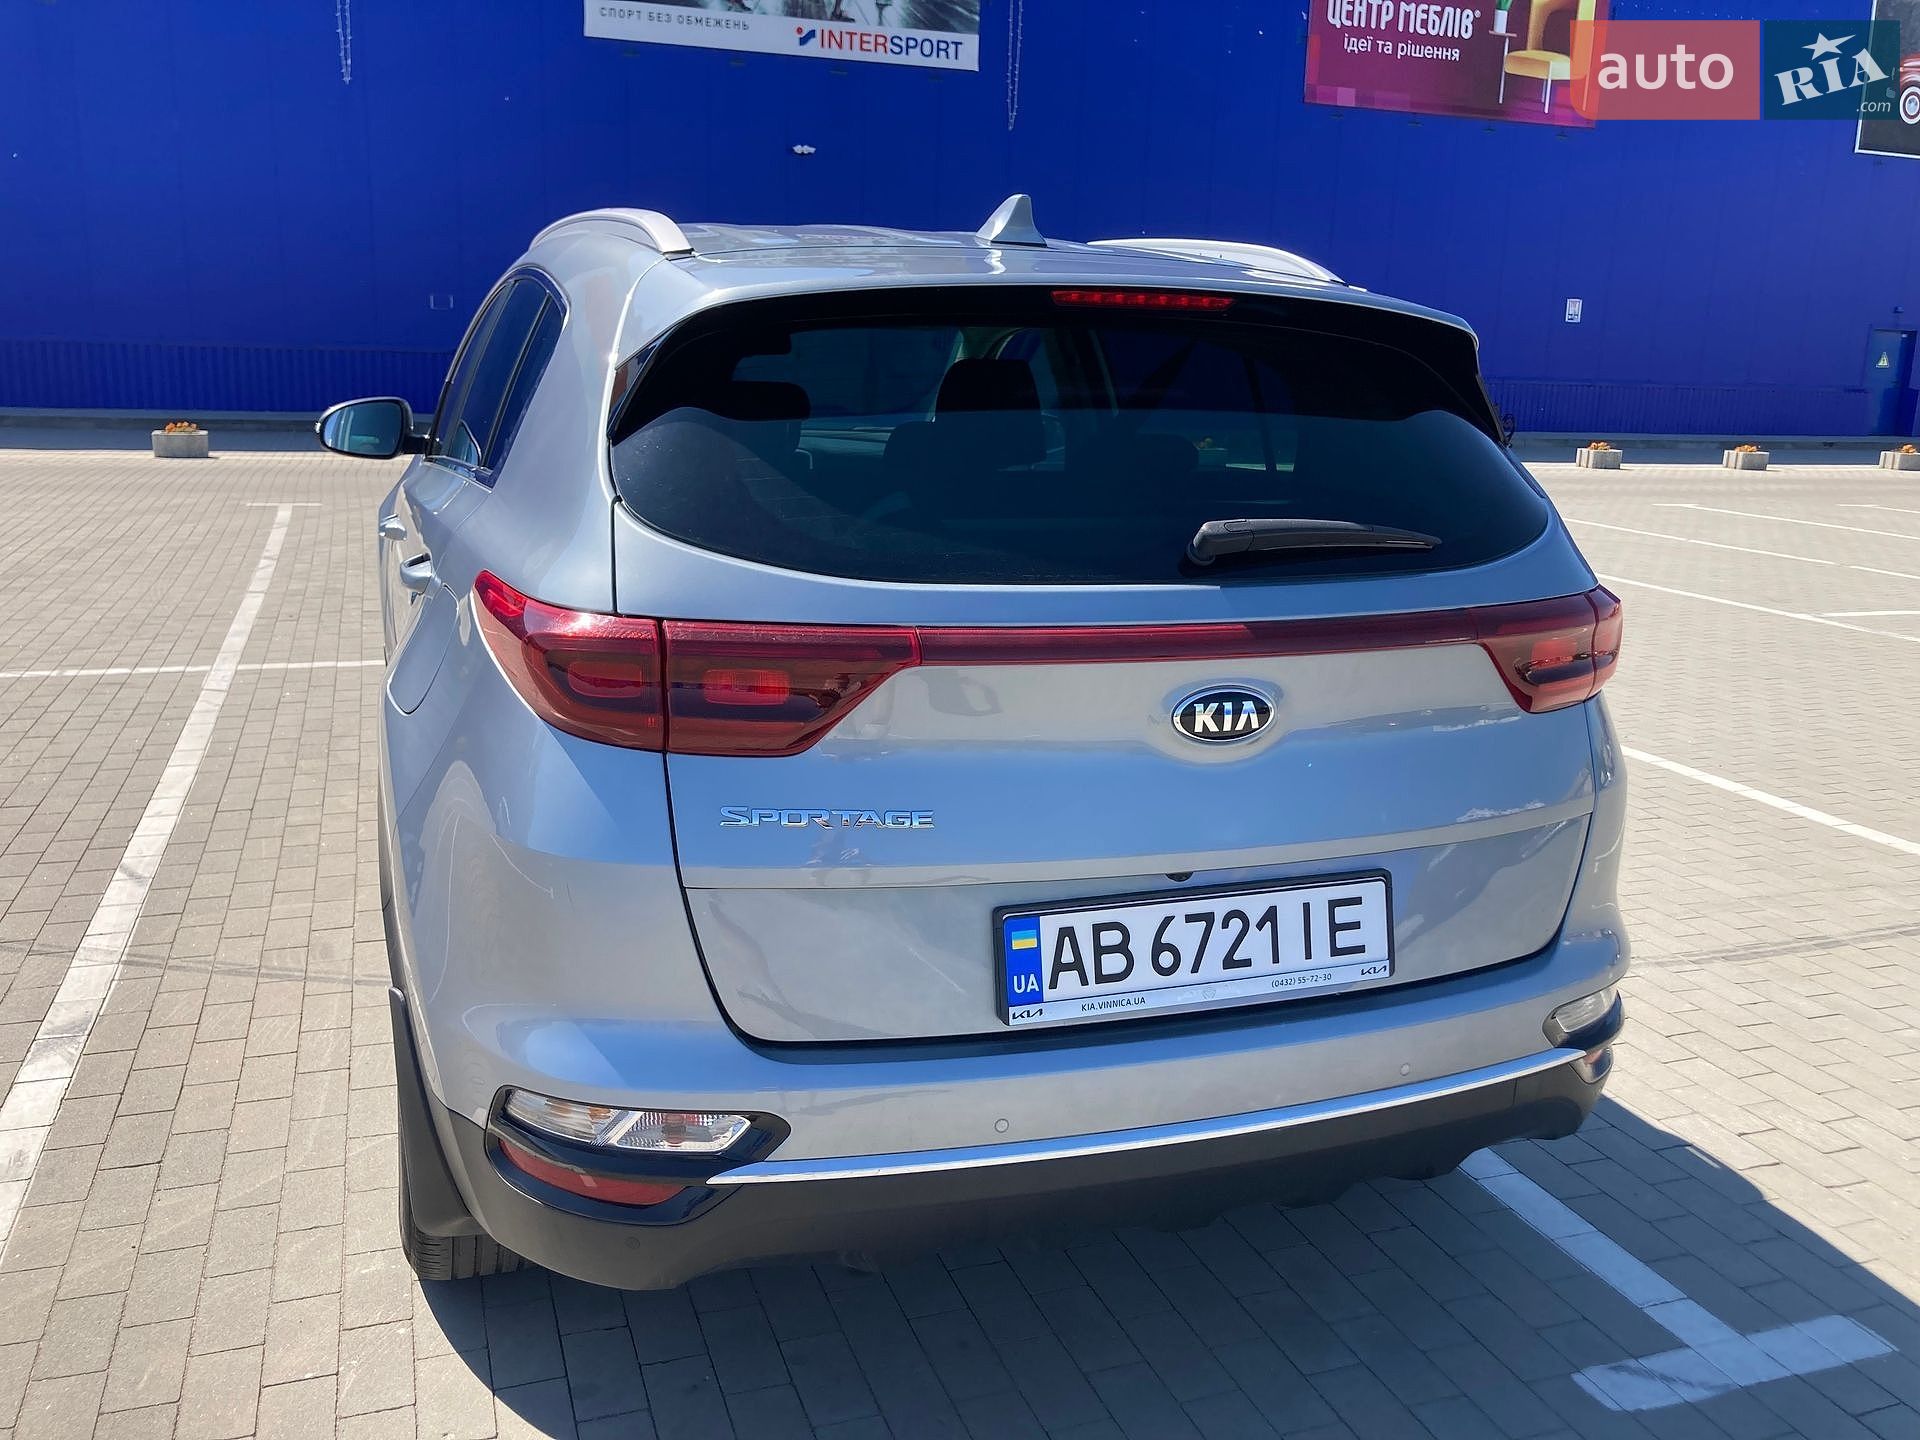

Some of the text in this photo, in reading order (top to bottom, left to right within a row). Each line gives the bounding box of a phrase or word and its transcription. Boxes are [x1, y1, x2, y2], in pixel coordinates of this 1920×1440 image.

[600, 7, 750, 31] СПОРТ БЕЗ ОБМЕЖЕНЬ
[1327, 0, 1395, 30] ЦЕНТР
[819, 28, 963, 61] INTERSPORT
[1343, 33, 1460, 62] ідеї та рішення
[1193, 700, 1260, 733] KIA
[719, 805, 936, 830] SPORTAGE
[1048, 896, 1367, 990] AB 6721 IE
[1013, 973, 1040, 994] UA
[1271, 972, 1332, 989] (0432) 55-72-30
[1081, 996, 1146, 1012] KIA.VINNICA.UA
